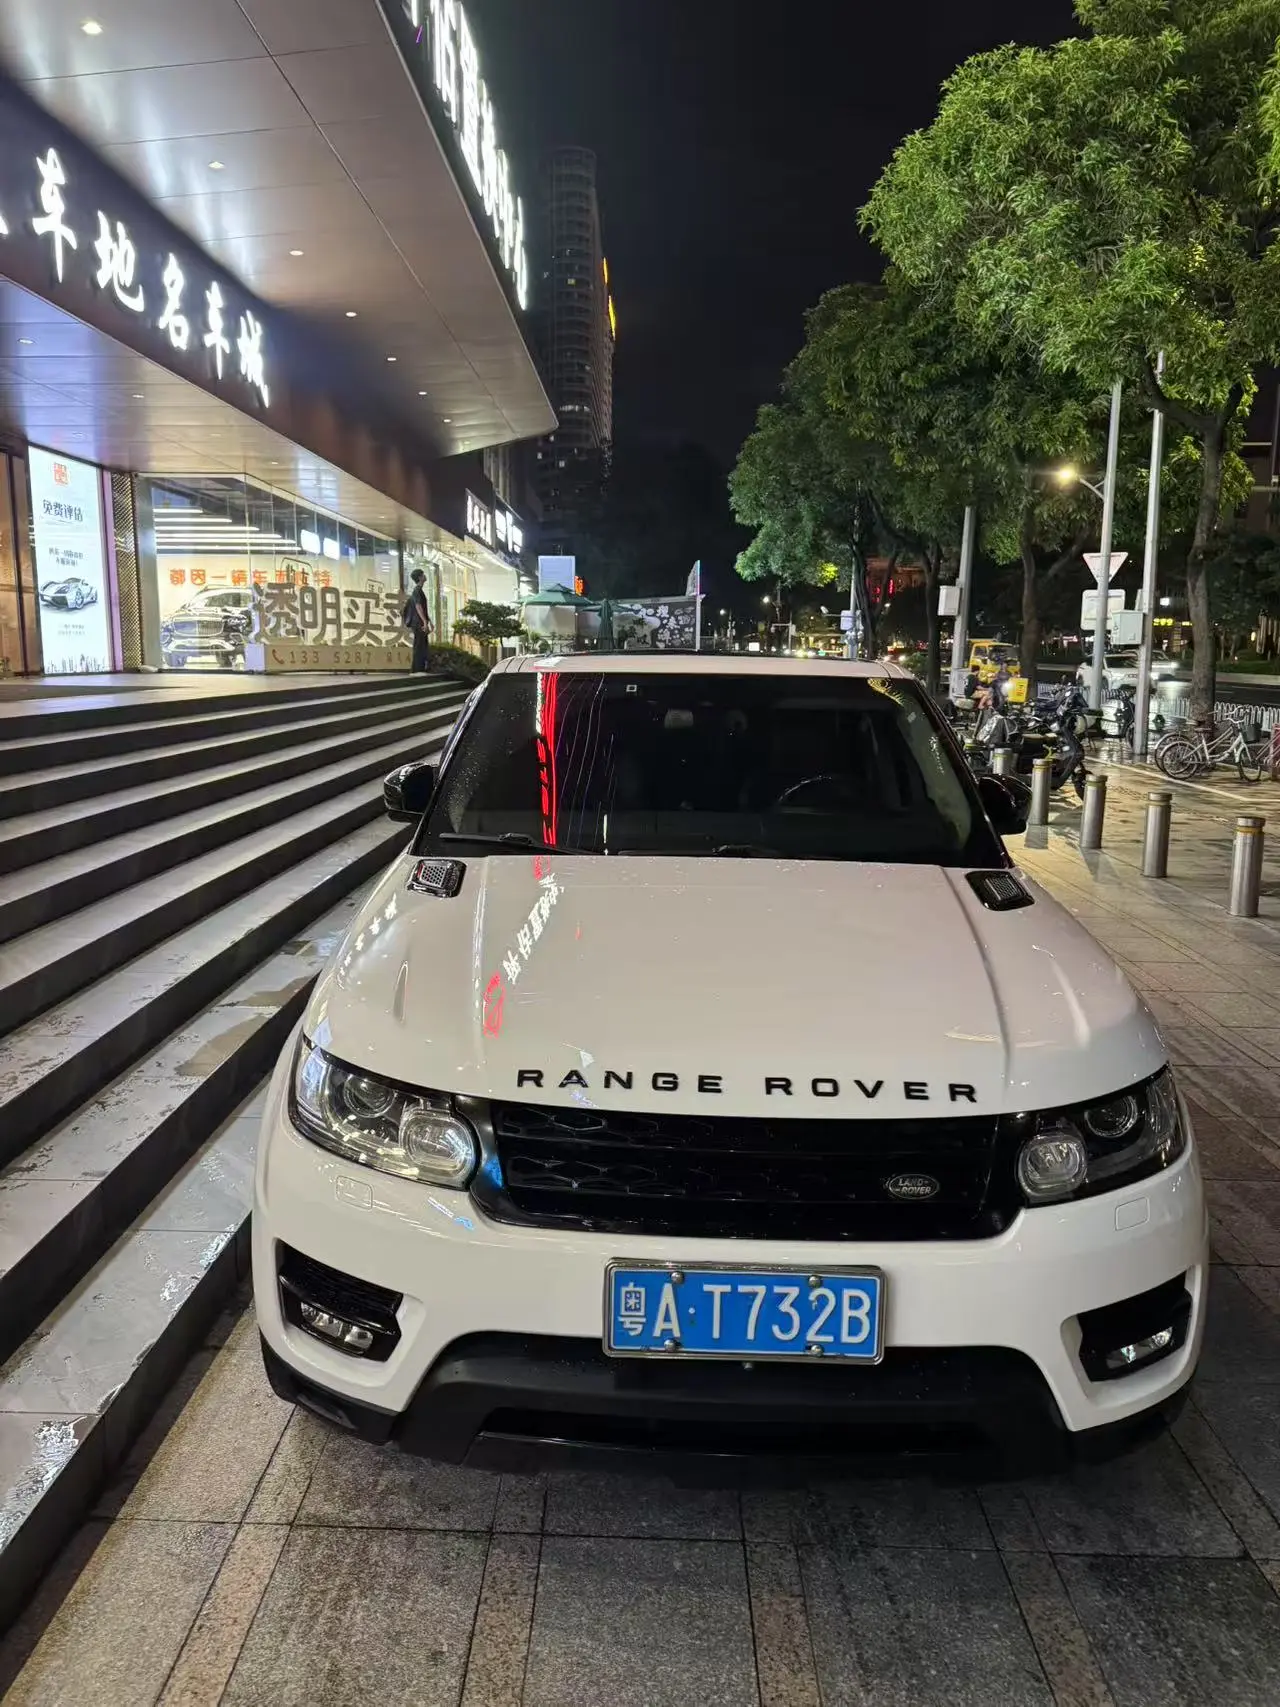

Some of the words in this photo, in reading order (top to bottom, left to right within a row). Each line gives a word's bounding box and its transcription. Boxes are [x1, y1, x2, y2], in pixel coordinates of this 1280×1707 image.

[403, 0, 529, 312] 估置换中心
[516, 1068, 723, 1093] RANGE
[764, 1077, 977, 1102] ROVER
